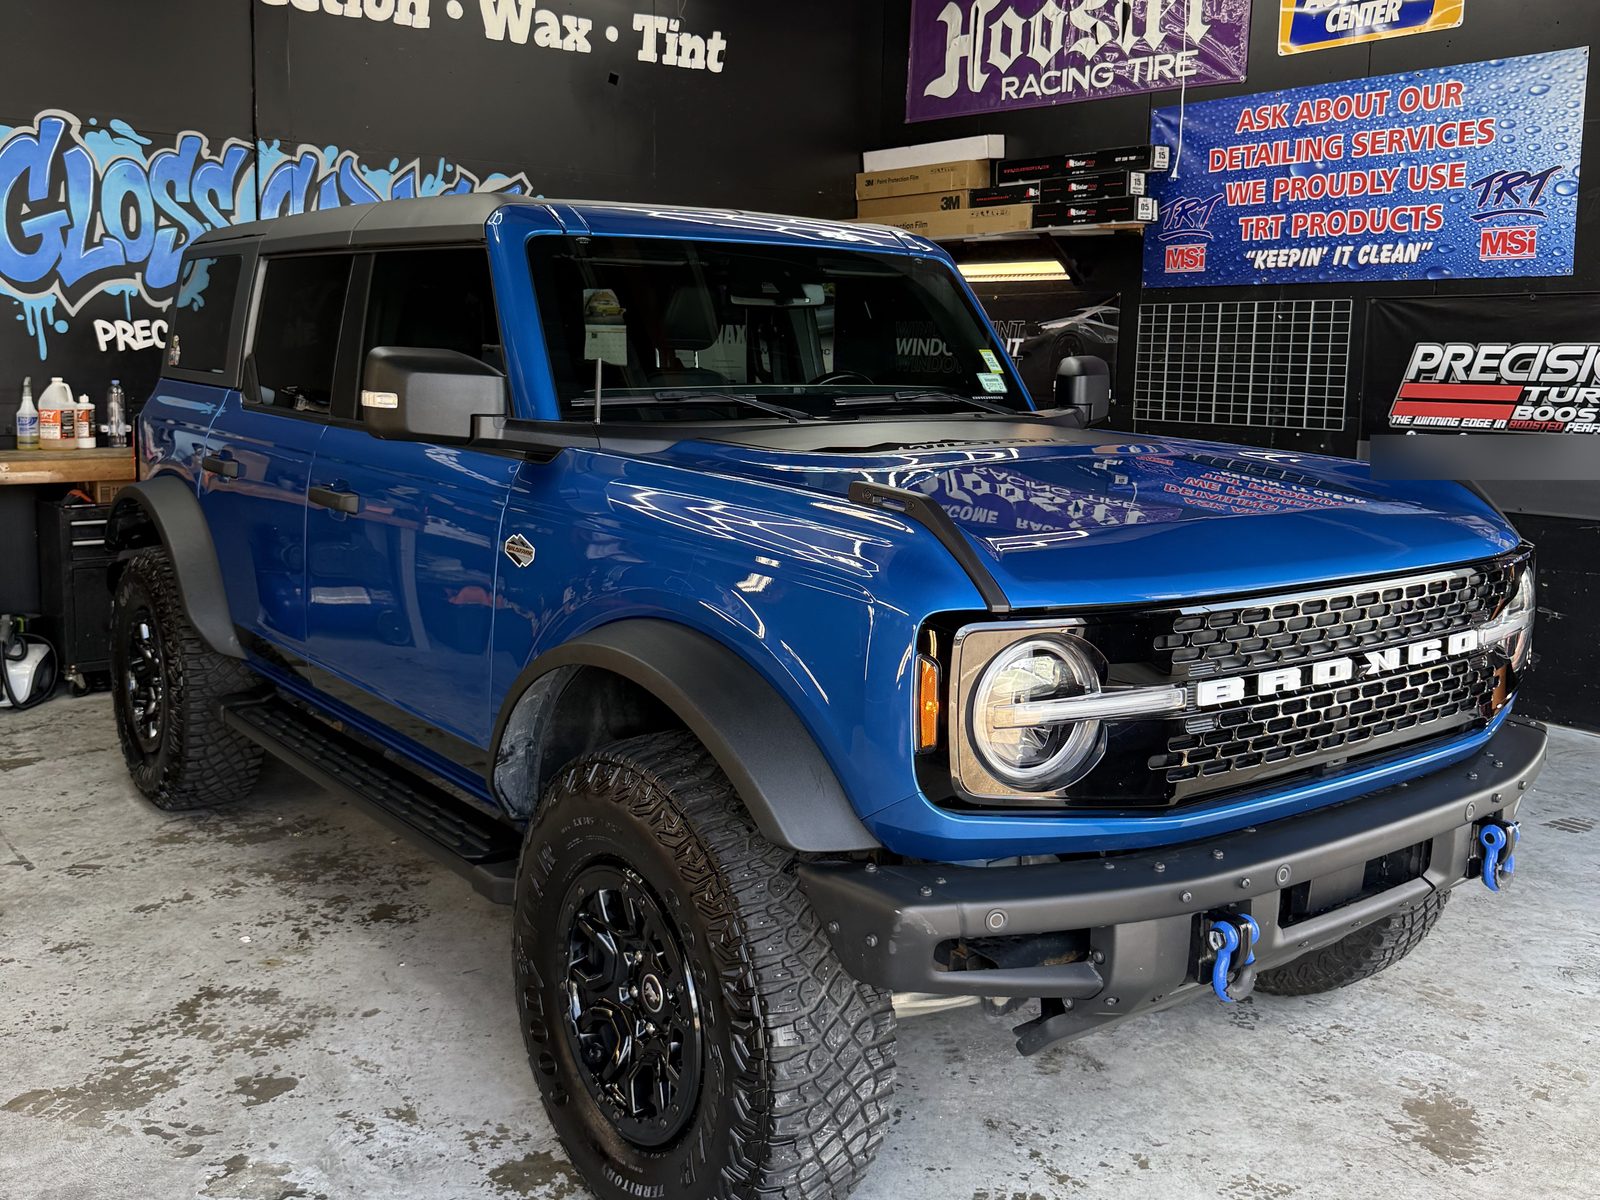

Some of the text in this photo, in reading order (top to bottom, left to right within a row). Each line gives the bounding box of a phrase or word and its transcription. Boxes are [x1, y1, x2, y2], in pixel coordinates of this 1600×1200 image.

[1326, 0, 1402, 33] CENTER
[478, 0, 592, 53] Wax
[632, 13, 727, 73] Tint
[1001, 50, 1199, 100] RACING TIRE
[1236, 81, 1464, 134] ASK ABOUT OUR
[1208, 118, 1496, 173] DETAILING SERVICES
[0, 115, 256, 287] GLOSS
[1134, 178, 1142, 186] 15
[1226, 162, 1466, 206] WE PROUDLY USE
[1470, 165, 1562, 208] TRT
[941, 195, 960, 211] 3M
[914, 220, 928, 229] Film
[1239, 204, 1444, 241] TRT PRODUCTS
[1333, 246, 1354, 266] IT
[94, 318, 168, 352] PREC
[1406, 344, 1600, 384] PRECISI
[1391, 415, 1413, 425] THE
[1413, 416, 1460, 427] WINNING
[1461, 417, 1491, 428] EDGE
[1493, 419, 1507, 429] IN
[1508, 420, 1565, 432] BOOSTED
[1511, 405, 1600, 423] BOOS
[1197, 629, 1478, 706] BRONCO
